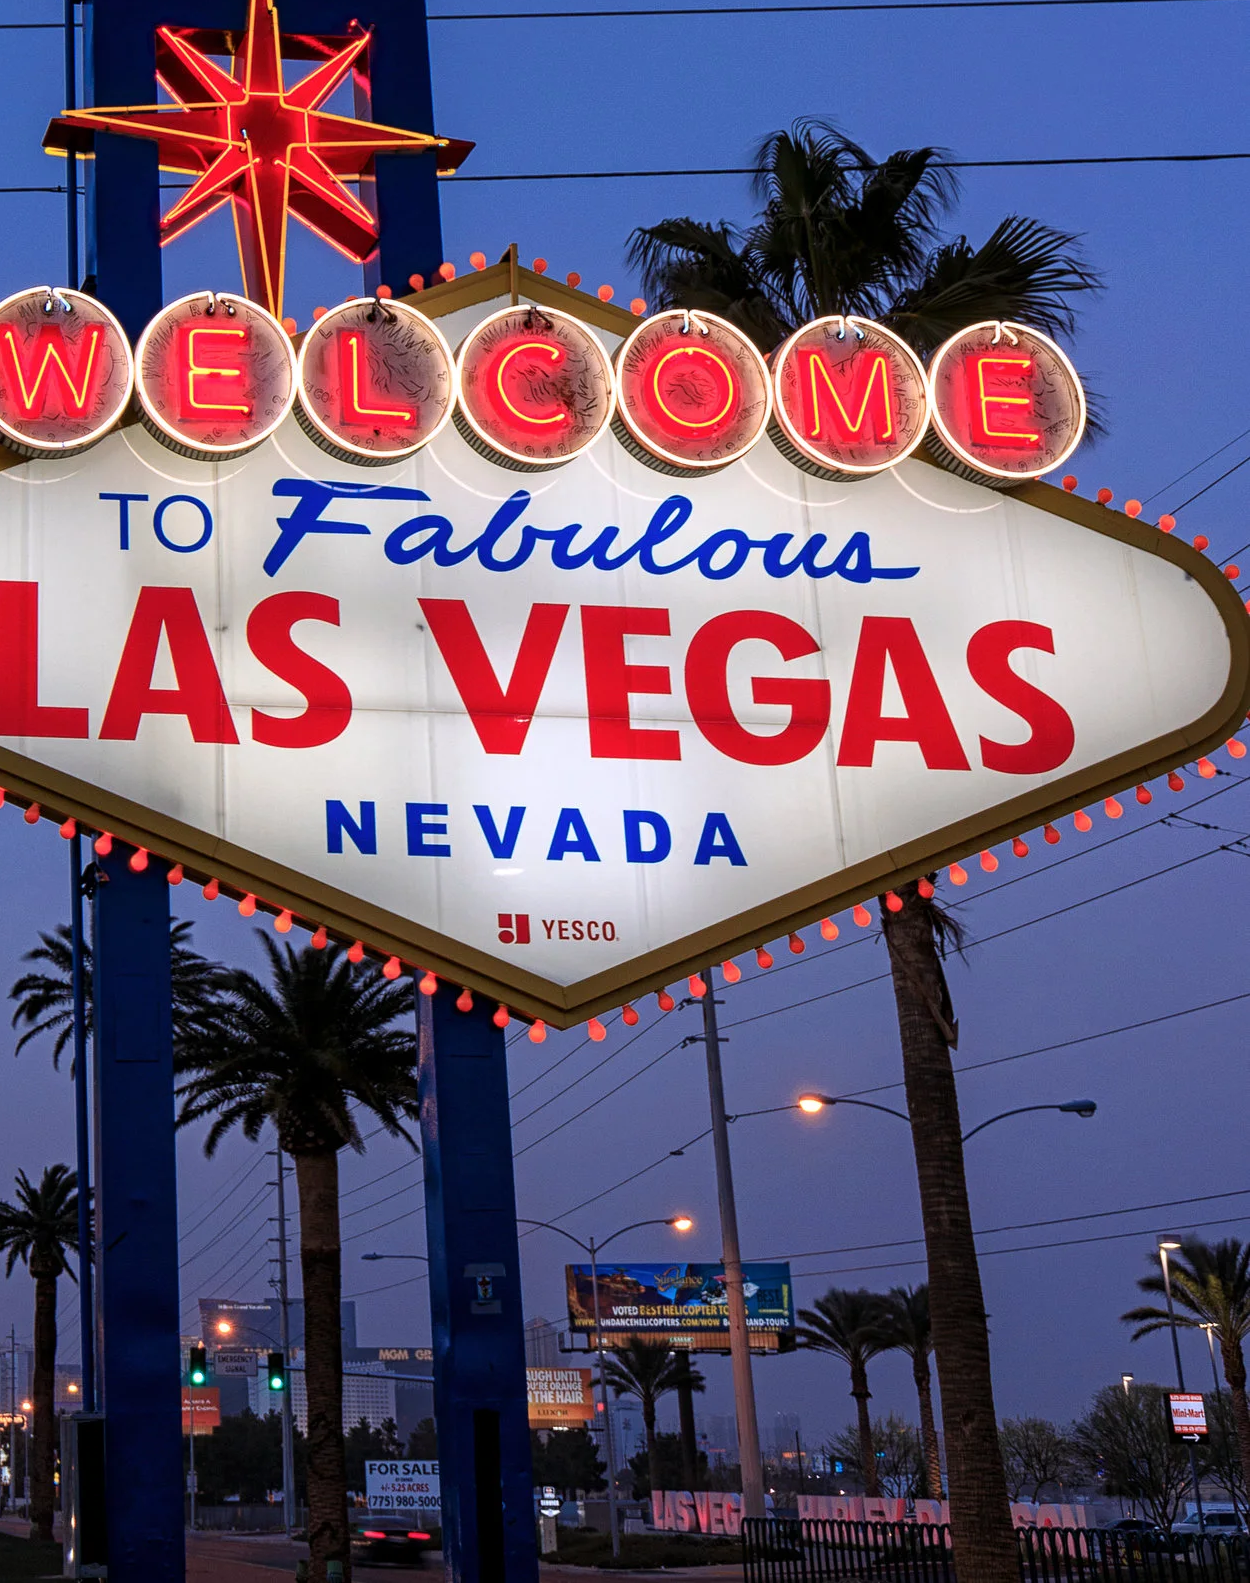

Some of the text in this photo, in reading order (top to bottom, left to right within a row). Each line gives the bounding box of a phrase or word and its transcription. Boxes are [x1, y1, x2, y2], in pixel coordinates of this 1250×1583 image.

[100, 478, 921, 581] TO Fabulous
[417, 598, 1076, 775] VEGAS
[326, 799, 748, 867] NEVADA
[542, 919, 616, 942] YESCO
[613, 1305, 638, 1316] VOTED
[639, 1304, 662, 1316] BEST
[663, 1304, 717, 1316] HELICOPTER
[717, 1304, 749, 1316] TOS
[575, 1318, 720, 1327] WWW.UNDANCEHELICOPTERS.COM/WOW
[218, 1355, 252, 1363] EMERGENCY
[379, 1349, 409, 1361] MGM
[225, 1365, 246, 1373] SIGNAL
[526, 1370, 582, 1381] AUGH UNTIL
[527, 1381, 583, 1391] OU'RE ORANGE
[534, 1391, 554, 1403] THE
[556, 1391, 584, 1404] HAIR
[1172, 1408, 1205, 1418] Mini-Mart
[369, 1463, 439, 1475] FOR SALE
[391, 1482, 406, 1492] 5.25
[407, 1483, 429, 1493] ACRES
[368, 1495, 393, 1508] (775)
[651, 1489, 696, 1531] LAS
